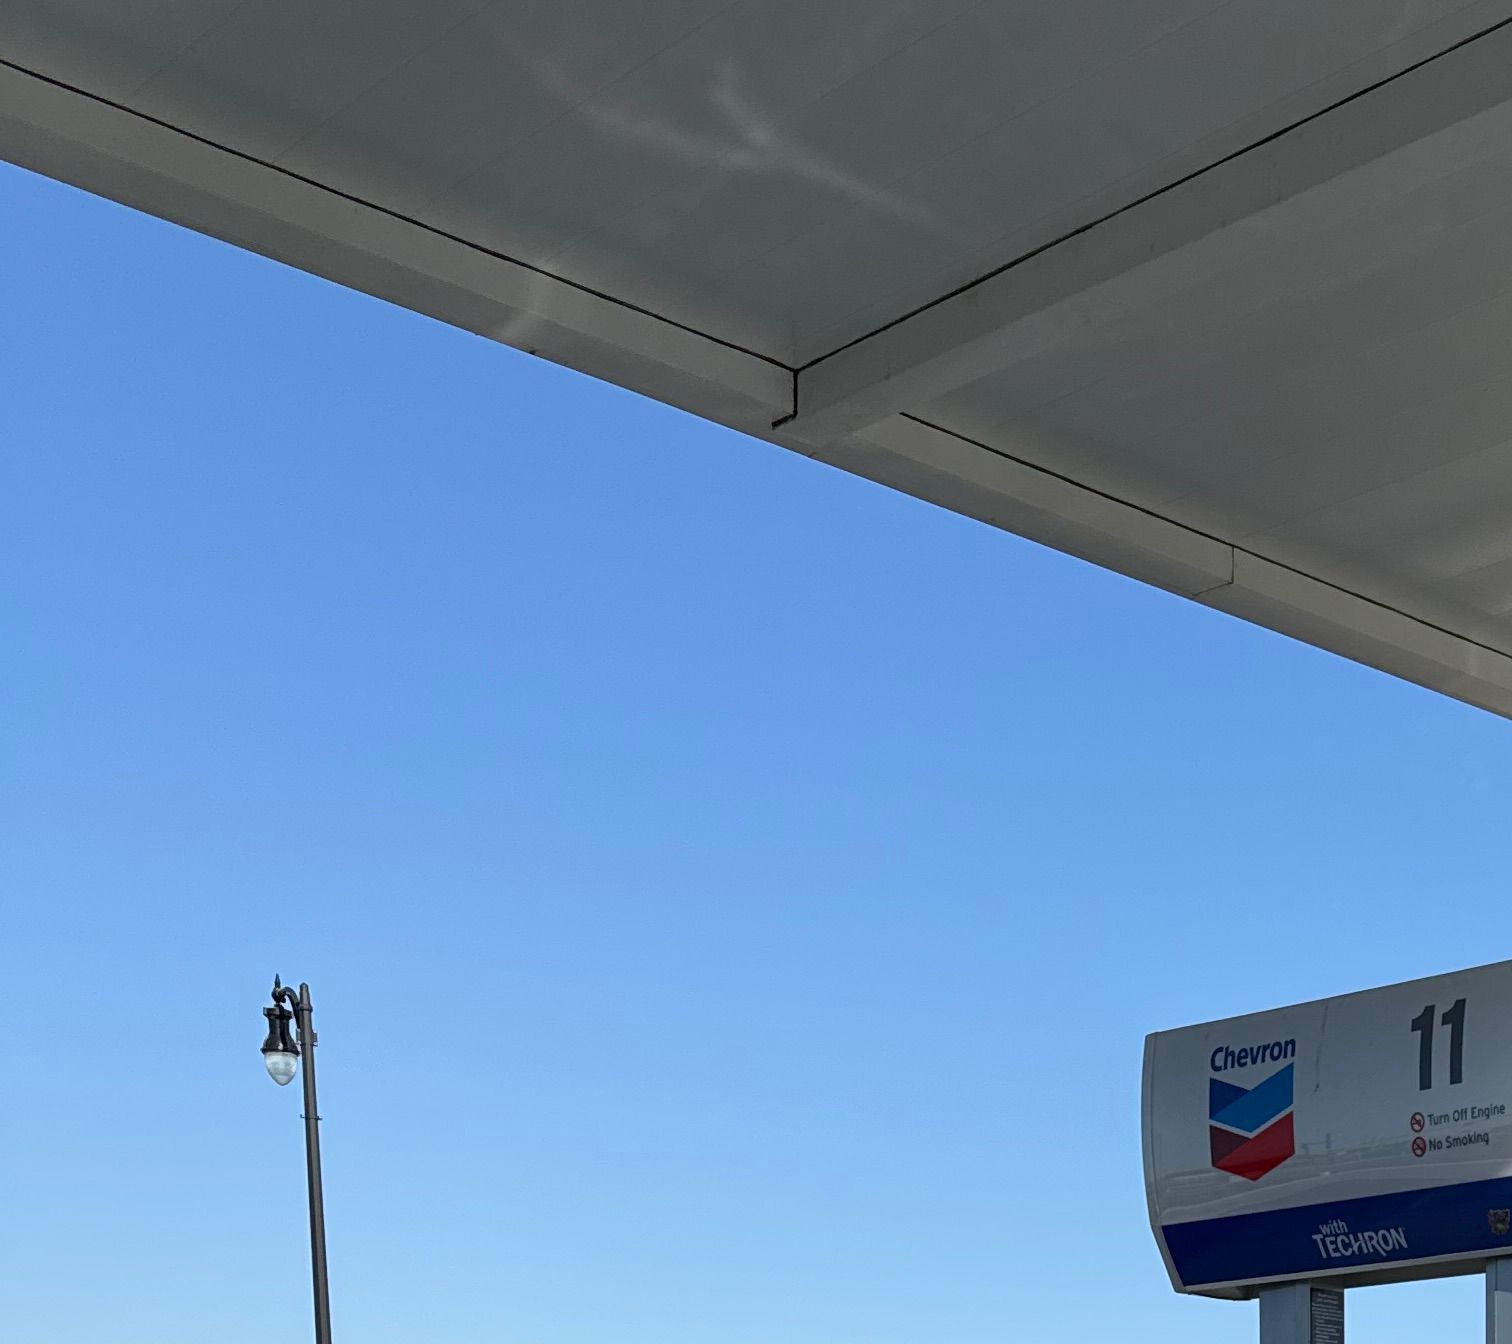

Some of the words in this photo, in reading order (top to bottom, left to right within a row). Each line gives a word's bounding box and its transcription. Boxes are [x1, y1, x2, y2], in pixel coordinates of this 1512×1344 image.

[1210, 1038, 1297, 1073] Chevron
[1410, 998, 1467, 1091] 11
[1427, 1113, 1450, 1126] Turn
[1452, 1107, 1468, 1122] Off
[1470, 1103, 1506, 1119] Engine
[1428, 1139, 1443, 1151] No
[1445, 1131, 1489, 1149] Smoking
[1319, 1218, 1348, 1236] with
[1311, 1227, 1408, 1259] TECHRON
